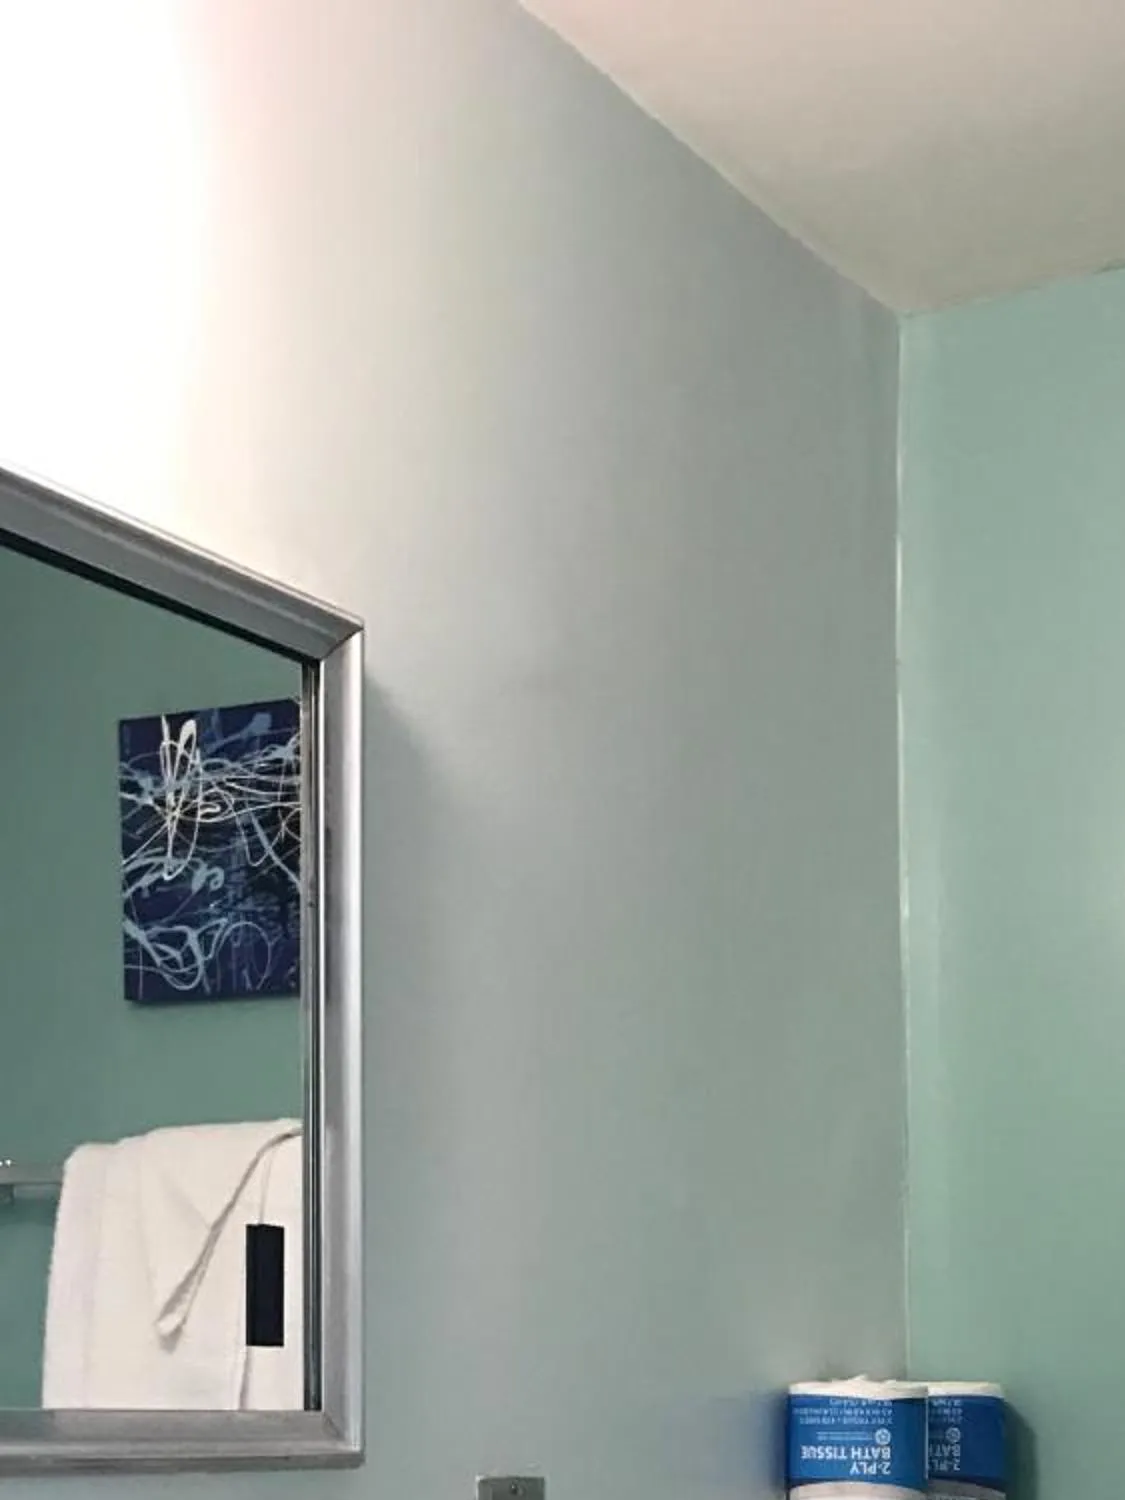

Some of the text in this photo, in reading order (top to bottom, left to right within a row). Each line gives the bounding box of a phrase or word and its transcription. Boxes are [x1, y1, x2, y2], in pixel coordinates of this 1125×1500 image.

[801, 1445, 891, 1460] BATH TISSUE
[850, 1461, 891, 1475] 2-PLY
